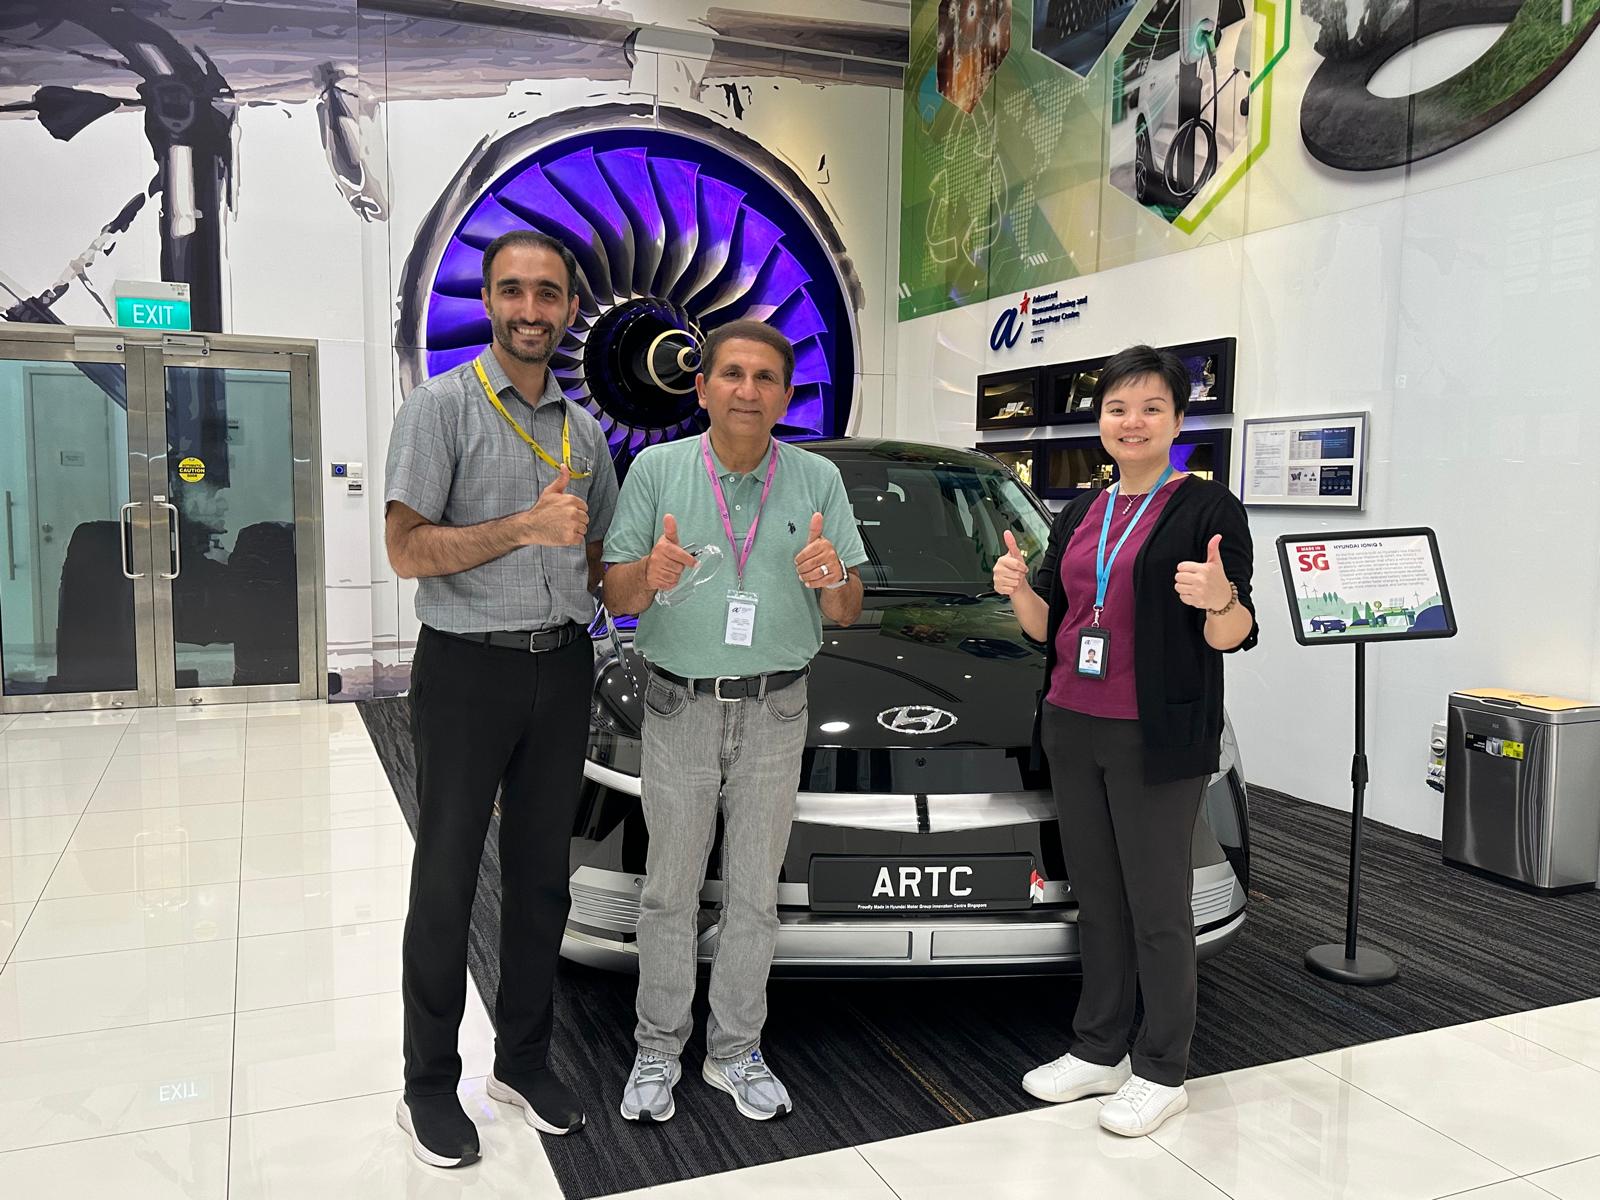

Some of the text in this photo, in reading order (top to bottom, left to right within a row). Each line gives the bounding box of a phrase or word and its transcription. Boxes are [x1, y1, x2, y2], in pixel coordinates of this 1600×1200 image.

[133, 303, 174, 325] EXIT
[1298, 553, 1330, 573] SG
[872, 866, 973, 897] ARTC
